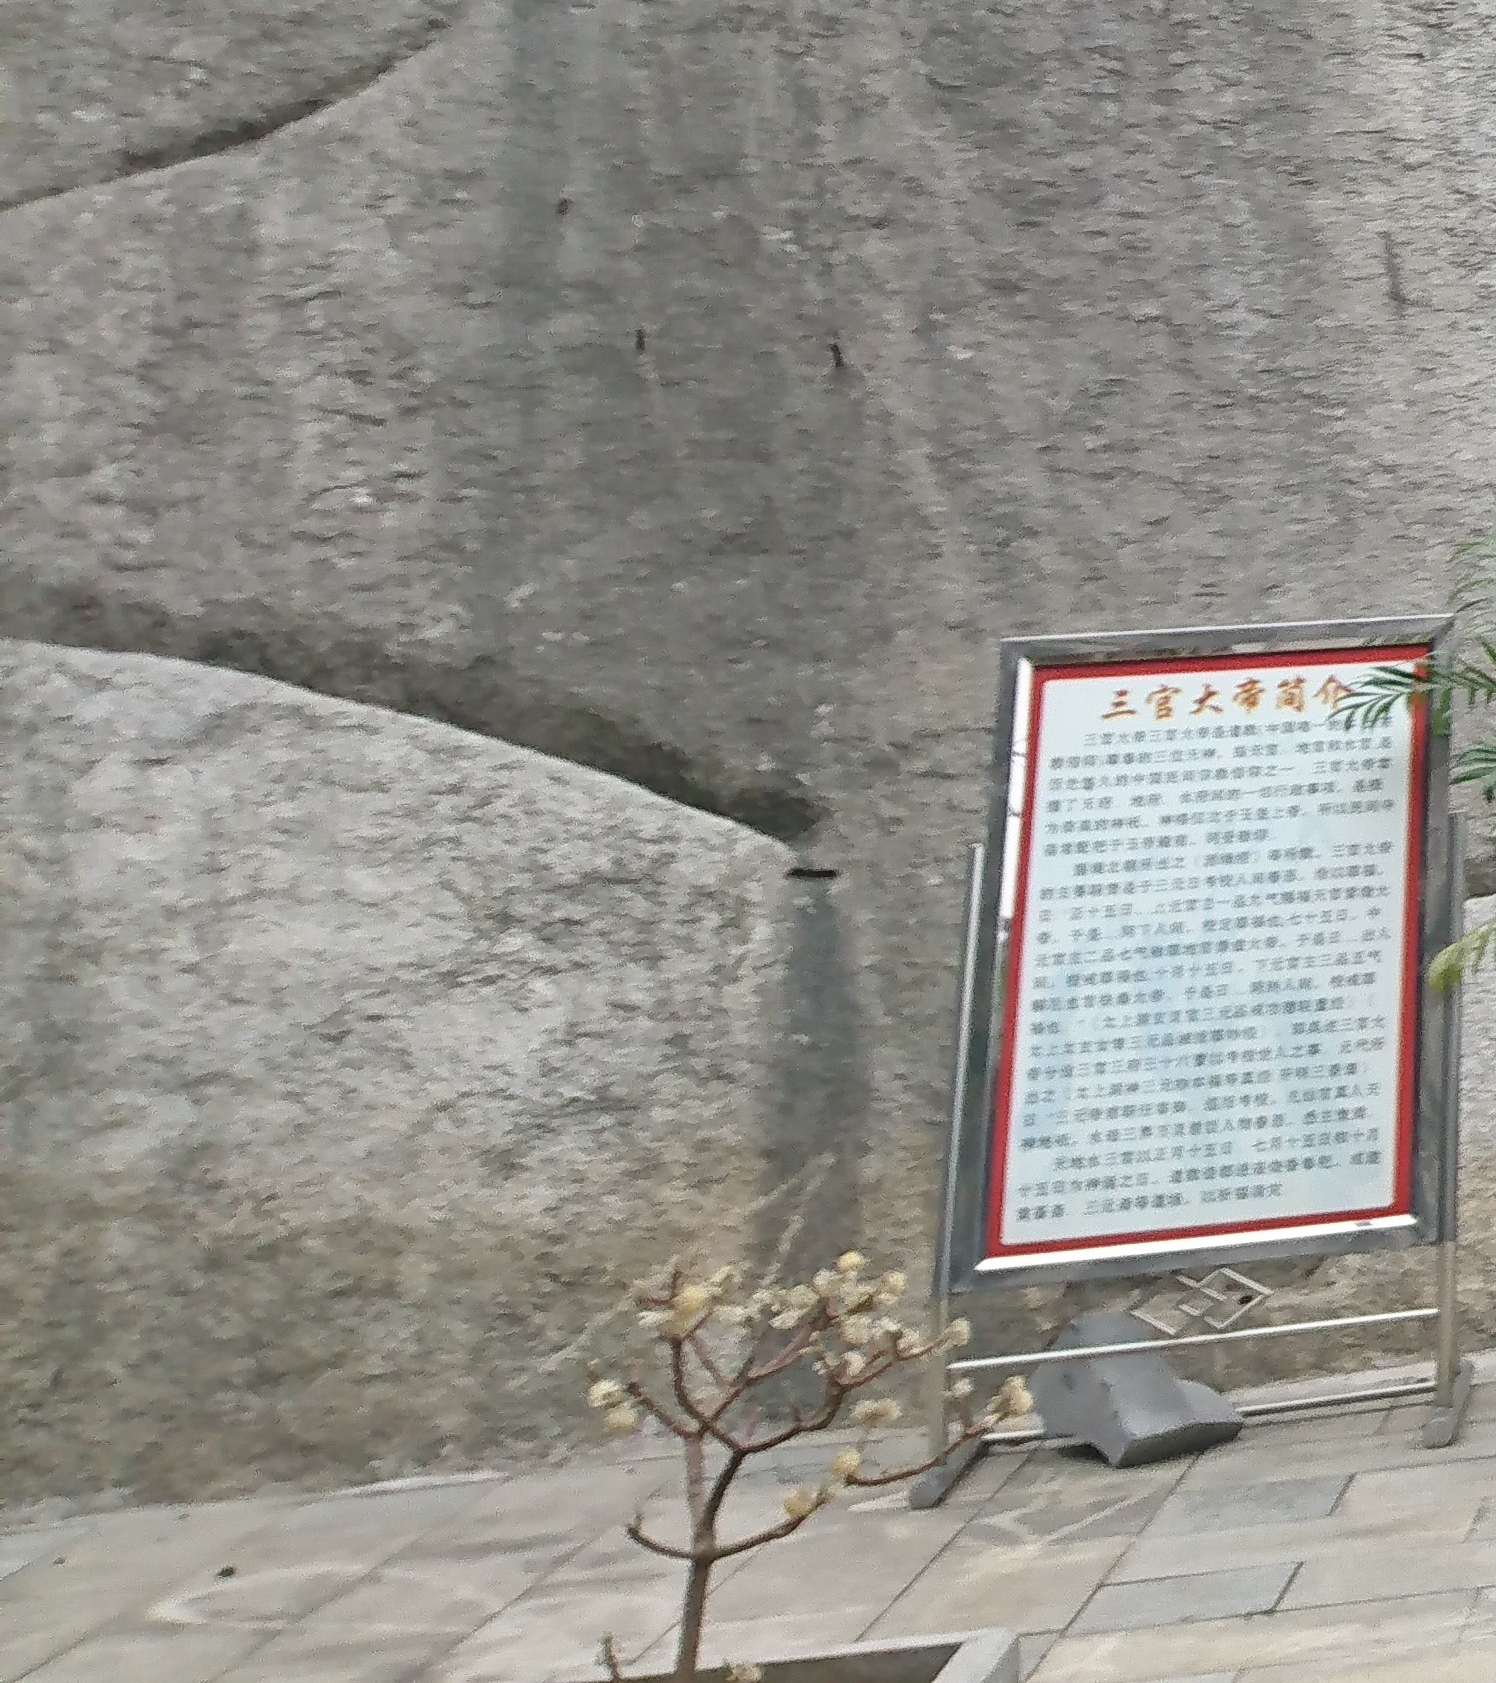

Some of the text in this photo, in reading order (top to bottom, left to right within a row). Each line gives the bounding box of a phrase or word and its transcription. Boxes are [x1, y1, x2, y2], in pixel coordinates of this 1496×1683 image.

[1101, 674, 1353, 720] 三官大帝简介
